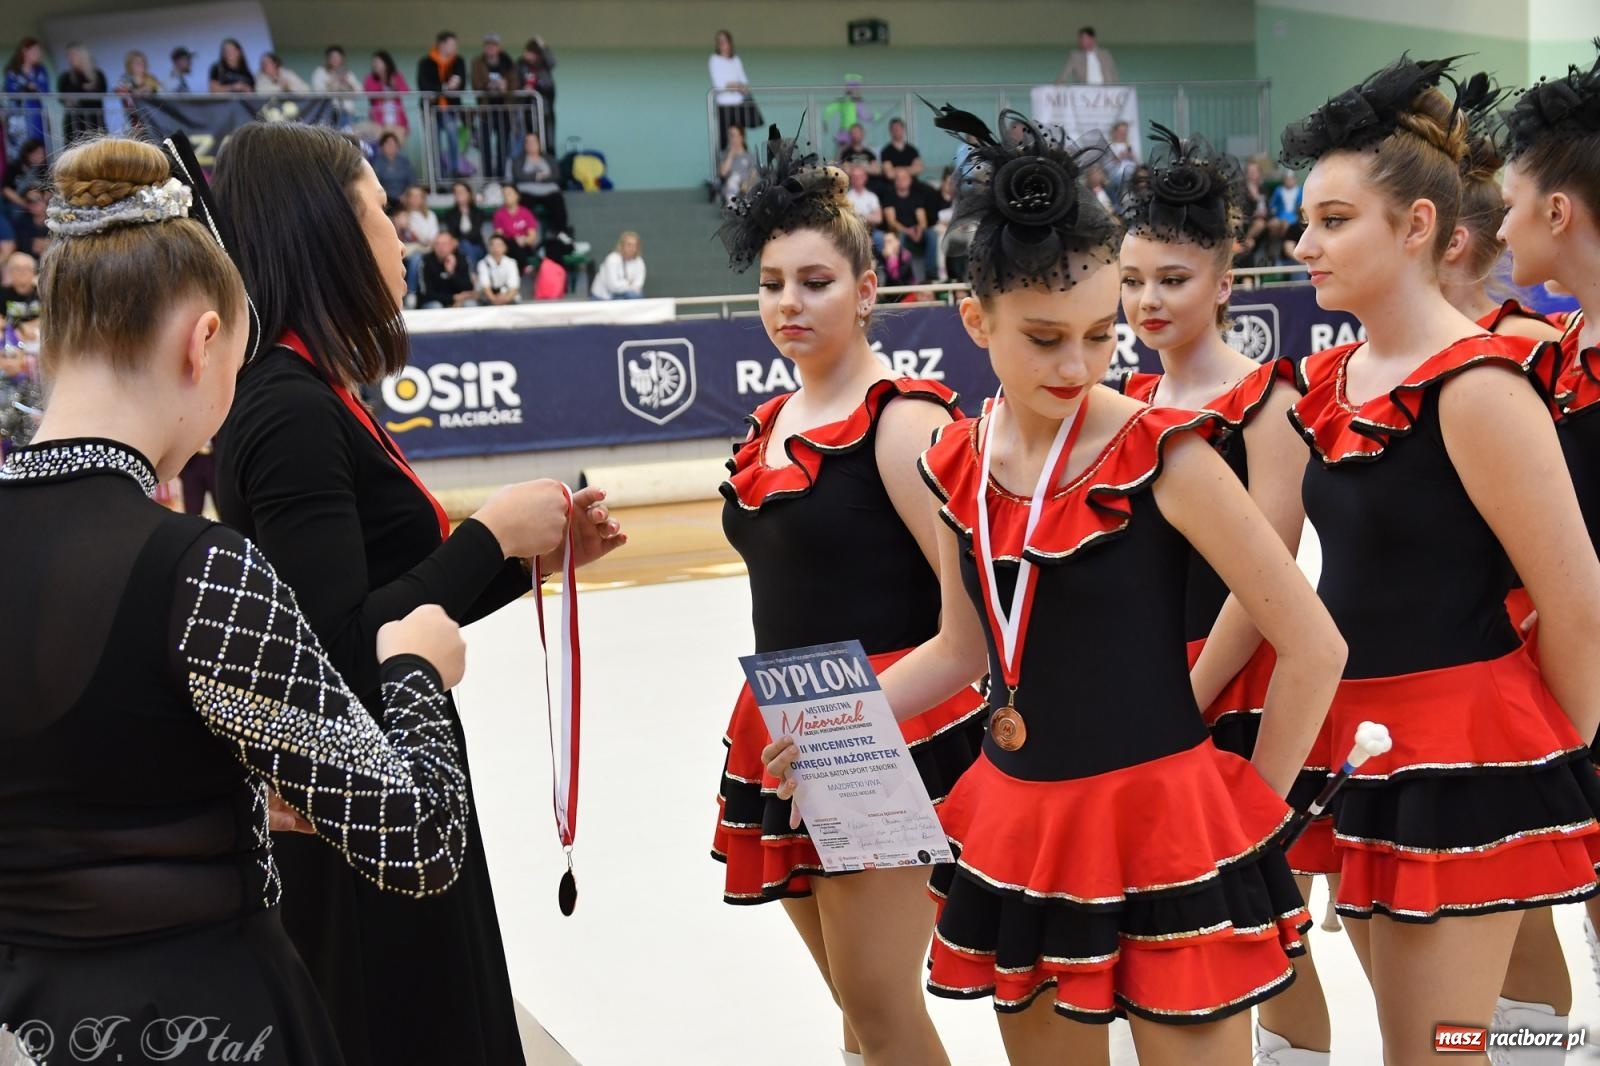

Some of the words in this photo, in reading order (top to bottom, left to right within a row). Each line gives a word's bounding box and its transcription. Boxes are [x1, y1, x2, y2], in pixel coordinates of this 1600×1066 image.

[439, 406, 523, 428] RACIBÓRZ
[755, 656, 870, 700] DYPLOM
[782, 700, 864, 737] Mażoretek
[804, 702, 852, 715] MISTRZOSTWA
[800, 744, 808, 754] II
[808, 735, 876, 752] WICEMISTRZ
[790, 757, 832, 770] OKRĘGU
[834, 748, 900, 766] MAŻORETEK
[801, 771, 829, 781] DEFILADA
[829, 768, 849, 777] BATON
[849, 766, 868, 775] SPORT
[868, 763, 898, 773] SENIORKI
